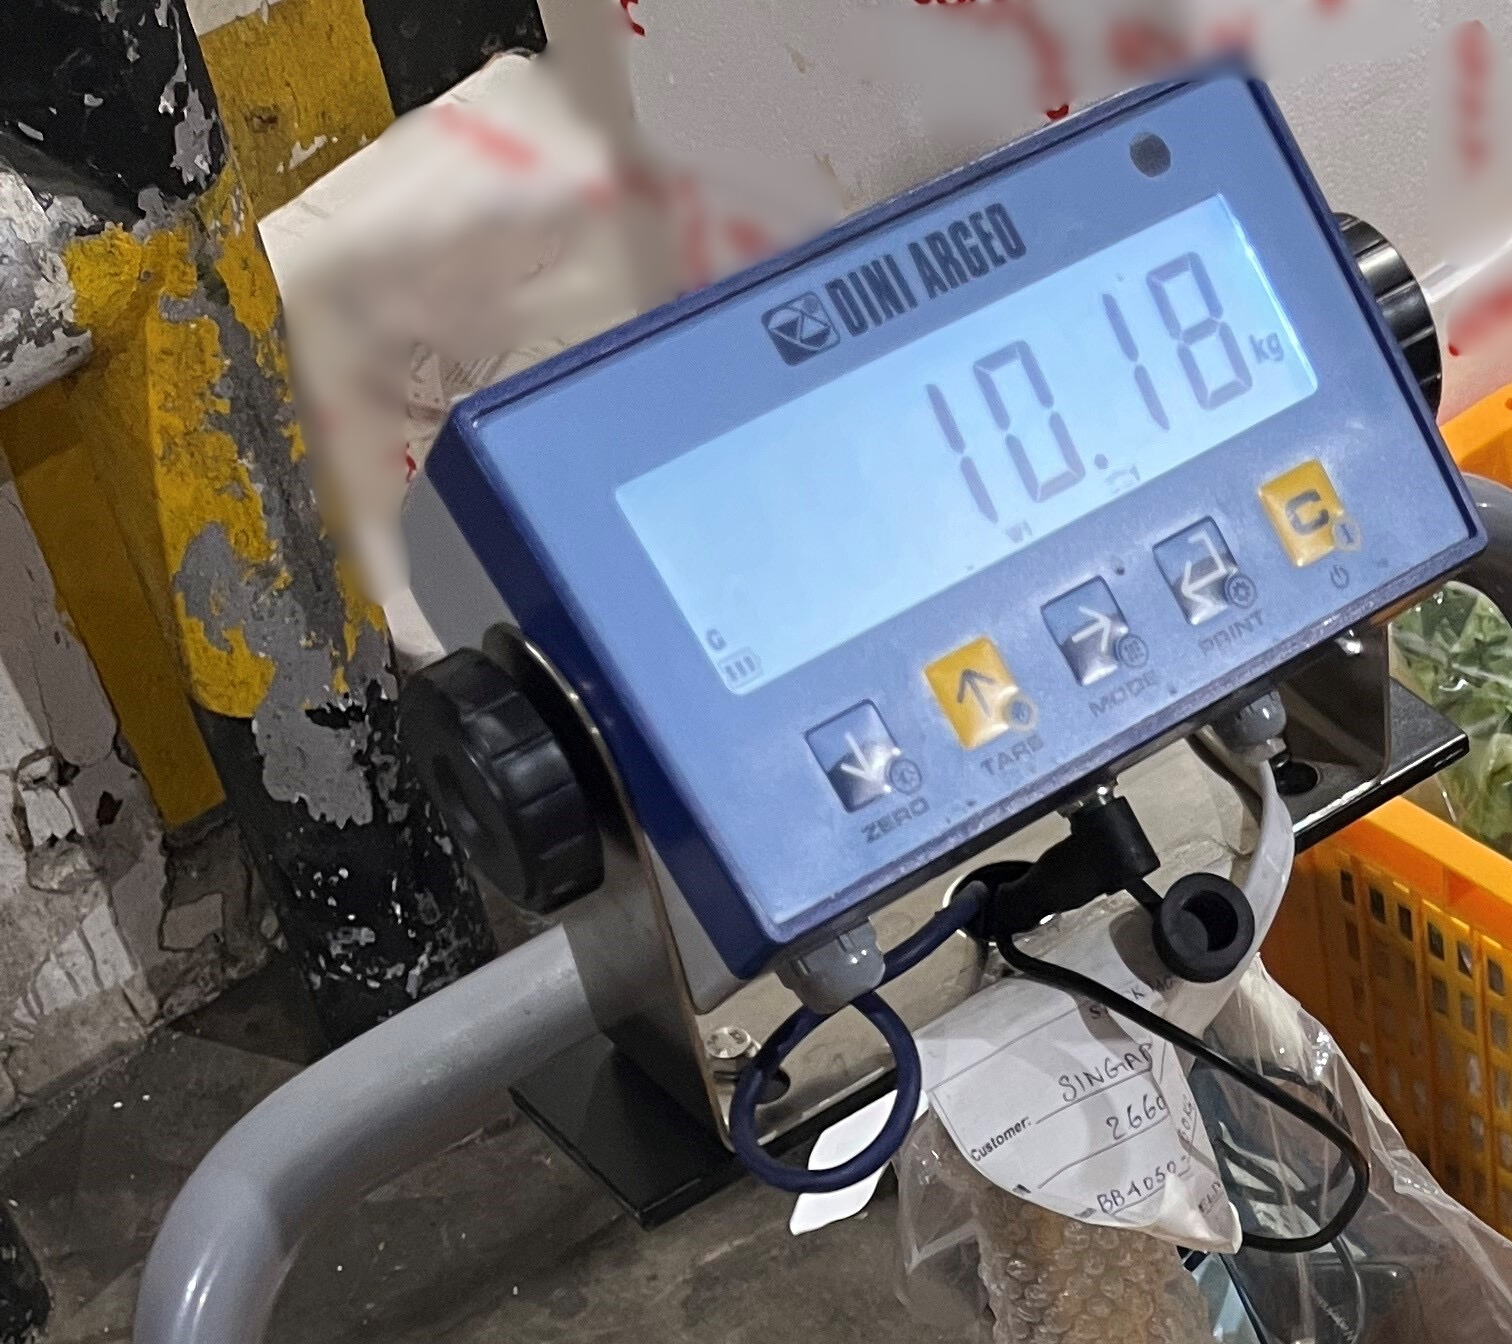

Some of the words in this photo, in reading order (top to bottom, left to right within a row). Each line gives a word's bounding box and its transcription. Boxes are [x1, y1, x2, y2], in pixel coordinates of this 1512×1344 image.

[825, 253, 918, 338] DINI
[906, 202, 1027, 300] ARGEO
[925, 251, 1253, 524] 10.18
[1248, 331, 1285, 364] kg
[1200, 608, 1264, 657] PRINT
[1088, 670, 1158, 717] MODE
[979, 733, 1045, 777] TARE
[860, 796, 931, 844] ZERO
[970, 1116, 1032, 1162] Customer:
